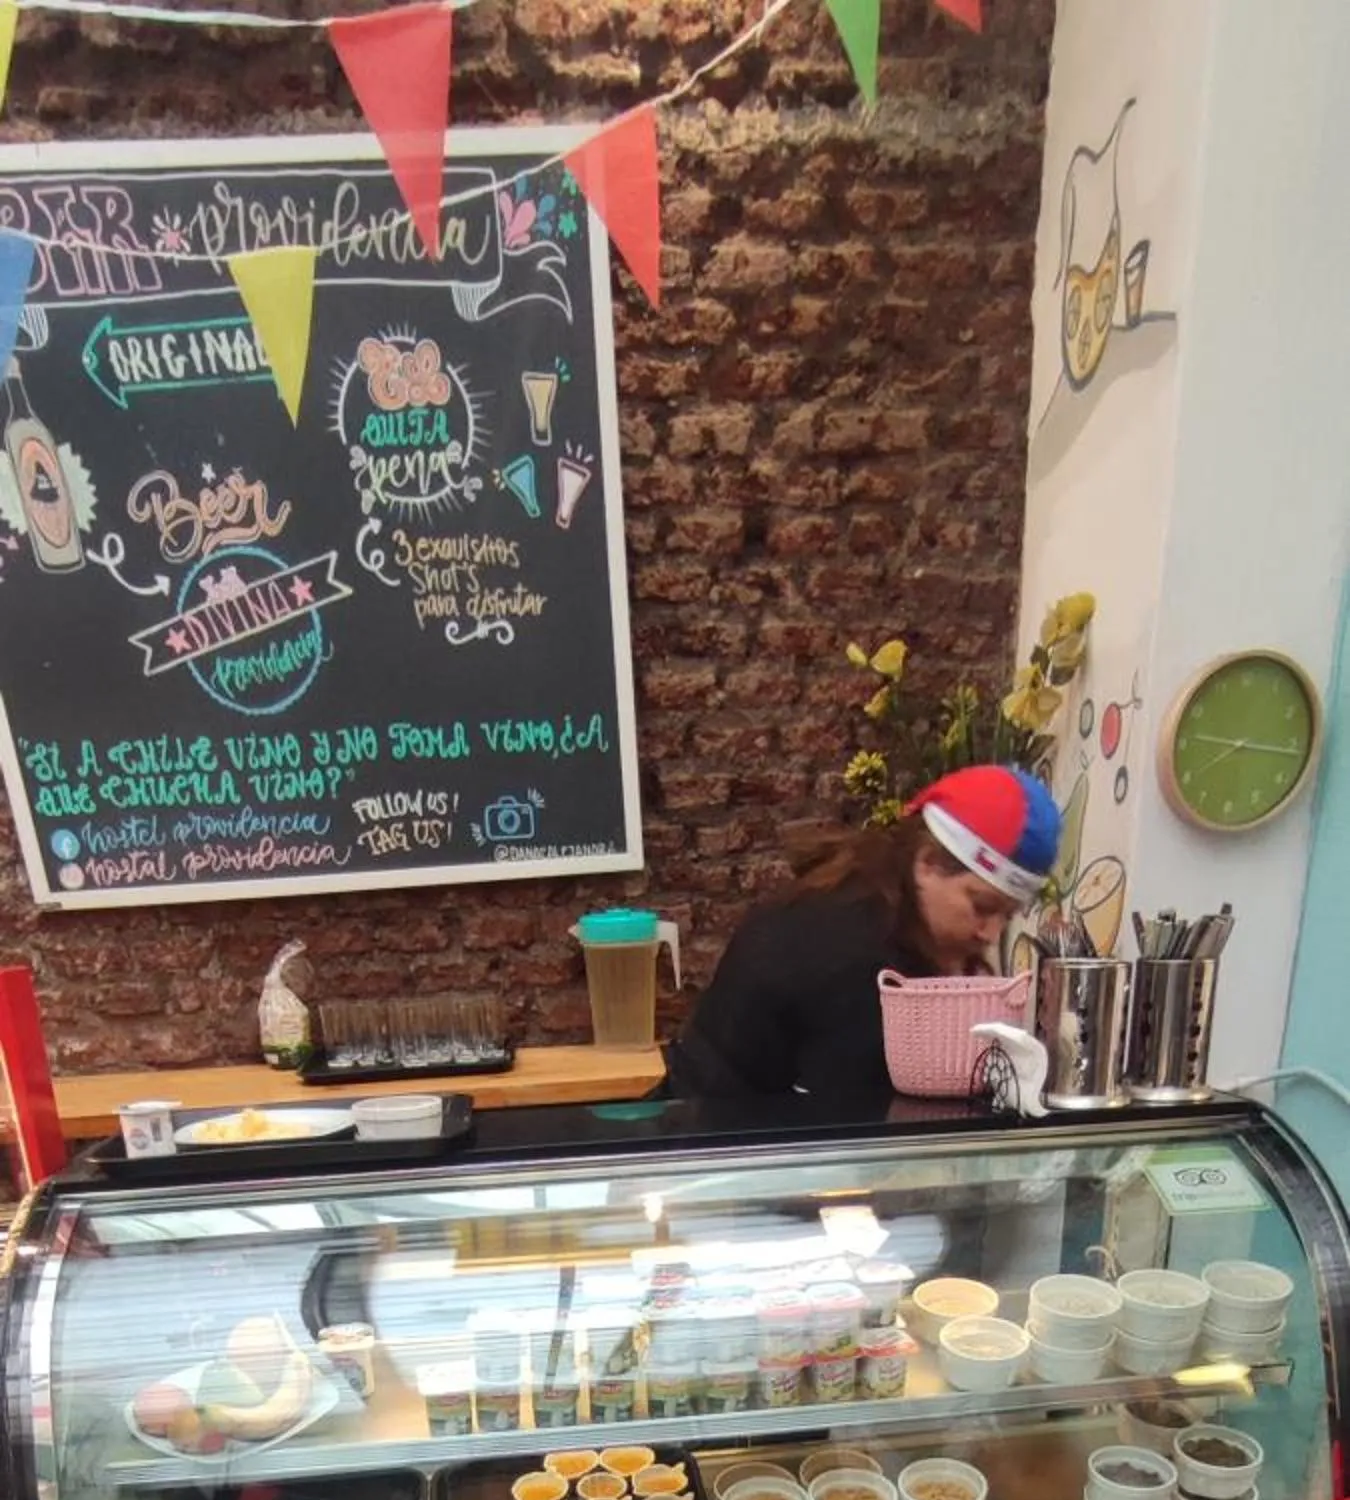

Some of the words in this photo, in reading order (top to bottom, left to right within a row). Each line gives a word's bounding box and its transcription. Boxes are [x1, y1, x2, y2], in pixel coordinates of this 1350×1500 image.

[127, 466, 292, 565] Beer
[392, 528, 414, 567] 3
[183, 578, 291, 651] DIVINA
[414, 593, 460, 641] para
[466, 582, 548, 621] disfrutar
[182, 836, 352, 881] providencia
[357, 820, 411, 856] TAG
